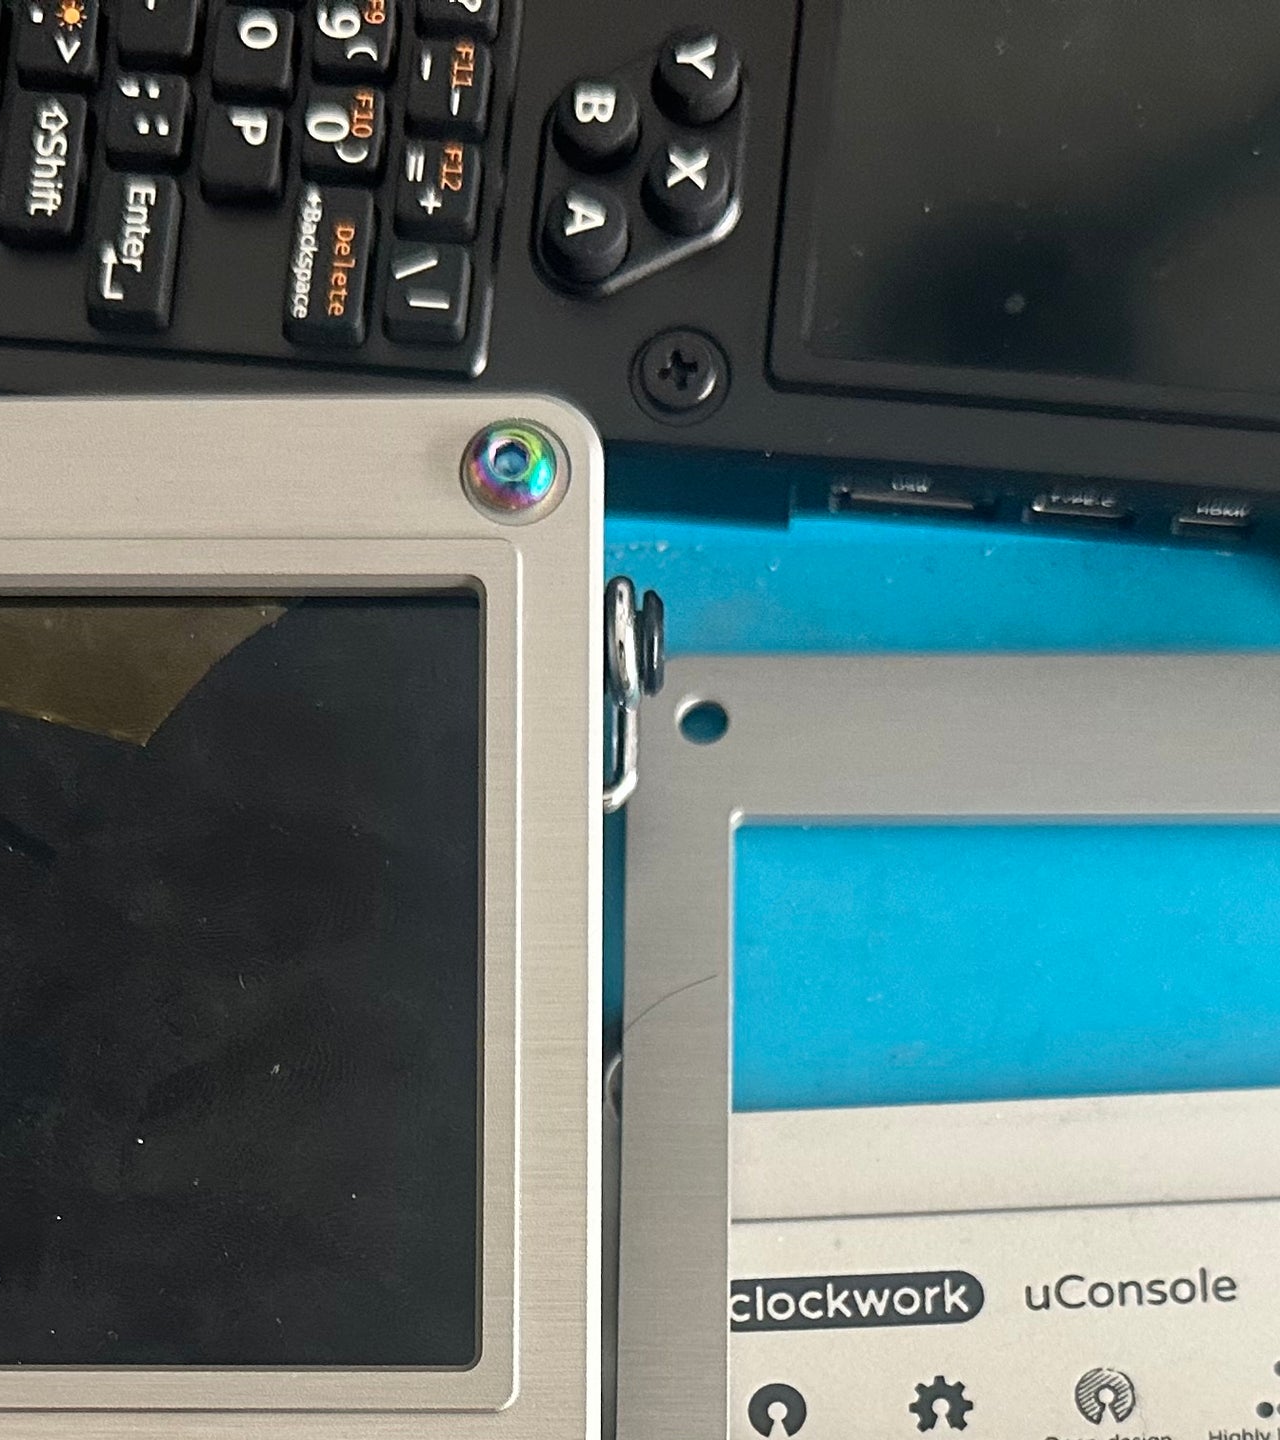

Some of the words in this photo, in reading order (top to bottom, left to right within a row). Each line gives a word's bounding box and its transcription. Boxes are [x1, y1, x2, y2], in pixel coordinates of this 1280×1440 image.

[238, 13, 278, 49] O
[318, 4, 361, 38] 9
[450, 42, 475, 87] F11
[675, 40, 717, 80] Y
[306, 106, 350, 142] 0
[351, 89, 374, 138] F10
[574, 88, 617, 123] B
[228, 110, 267, 145] P
[29, 131, 68, 216] Shift
[440, 144, 463, 191] F12
[667, 149, 709, 190] X
[122, 181, 156, 272] Enter
[565, 196, 606, 236] A
[290, 207, 321, 319] Backspace
[329, 220, 356, 317] Delete
[1196, 504, 1249, 518] HDMI
[730, 1279, 969, 1322] clockwork
[1024, 1267, 1237, 1311] uConsole
